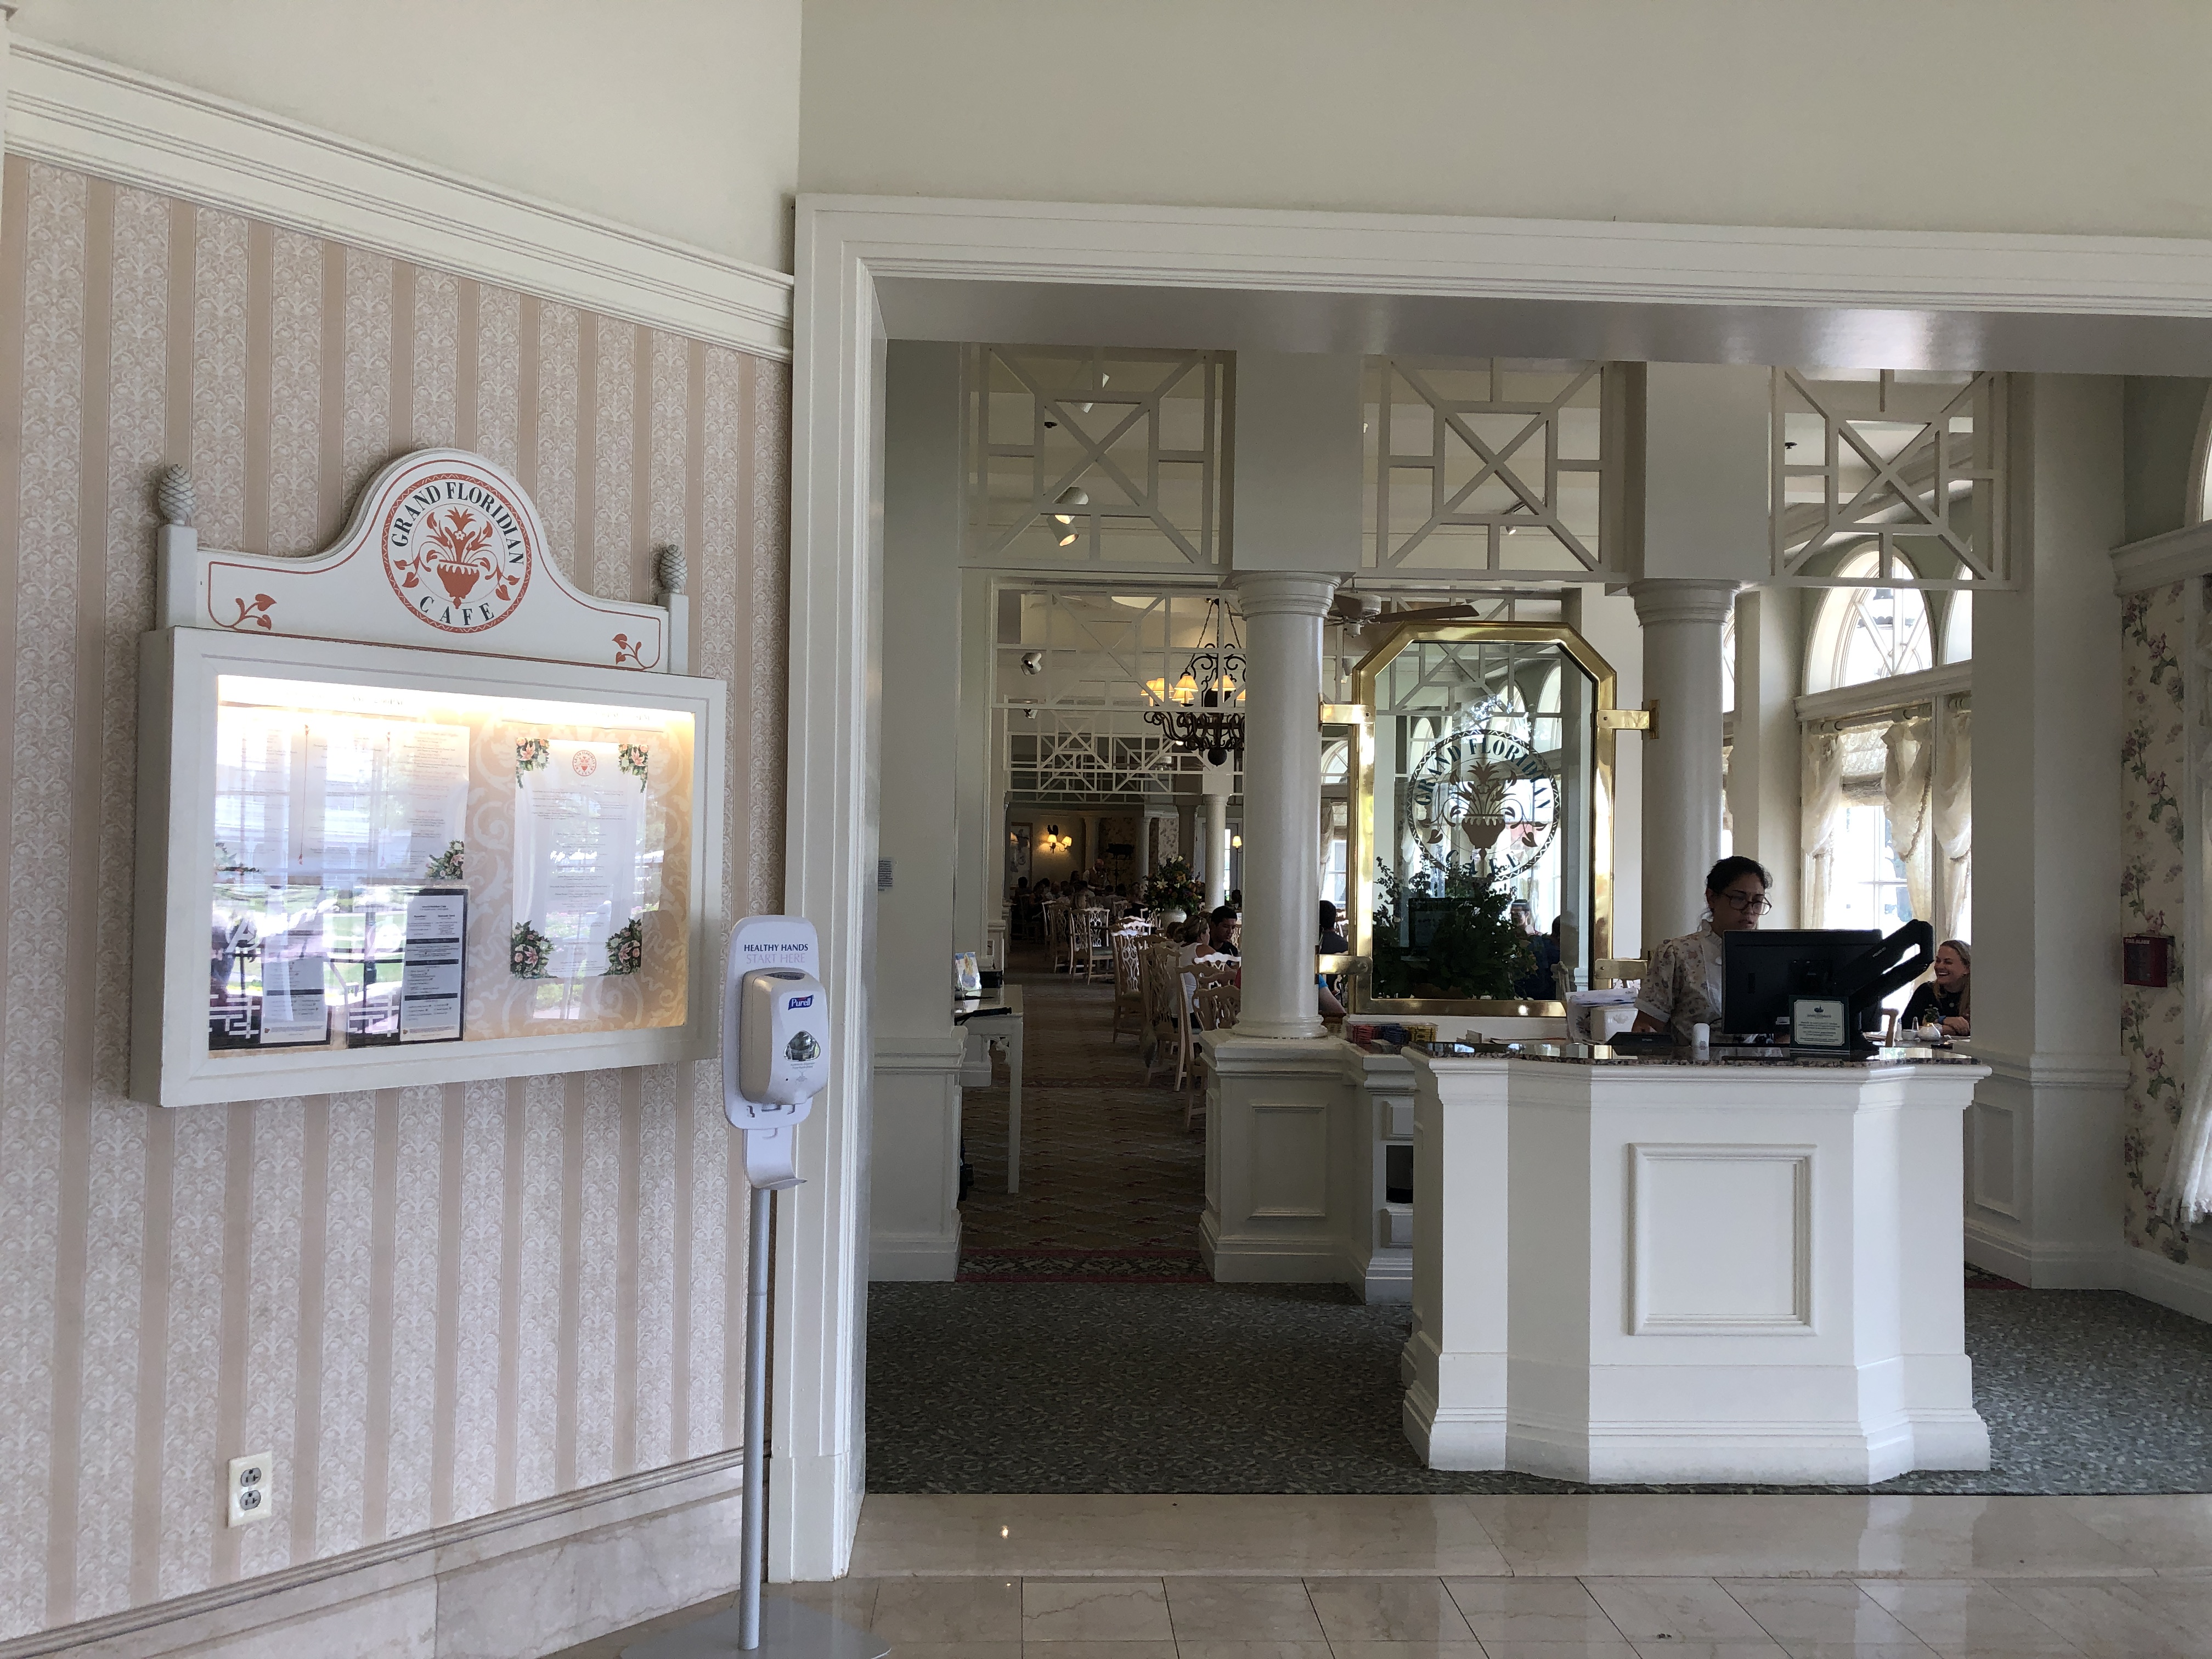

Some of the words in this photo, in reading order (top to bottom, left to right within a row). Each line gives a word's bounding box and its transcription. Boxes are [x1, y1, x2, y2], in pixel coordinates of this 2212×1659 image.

[391, 485, 441, 547] GRAND
[445, 482, 524, 565] FLORIDIAN
[420, 596, 494, 626] CAFE
[1416, 745, 1462, 806] GRAND
[1469, 737, 1551, 809] FLORIDIAN
[744, 944, 779, 952] HEALTHY
[746, 953, 776, 964] START
[780, 953, 805, 963] HERE
